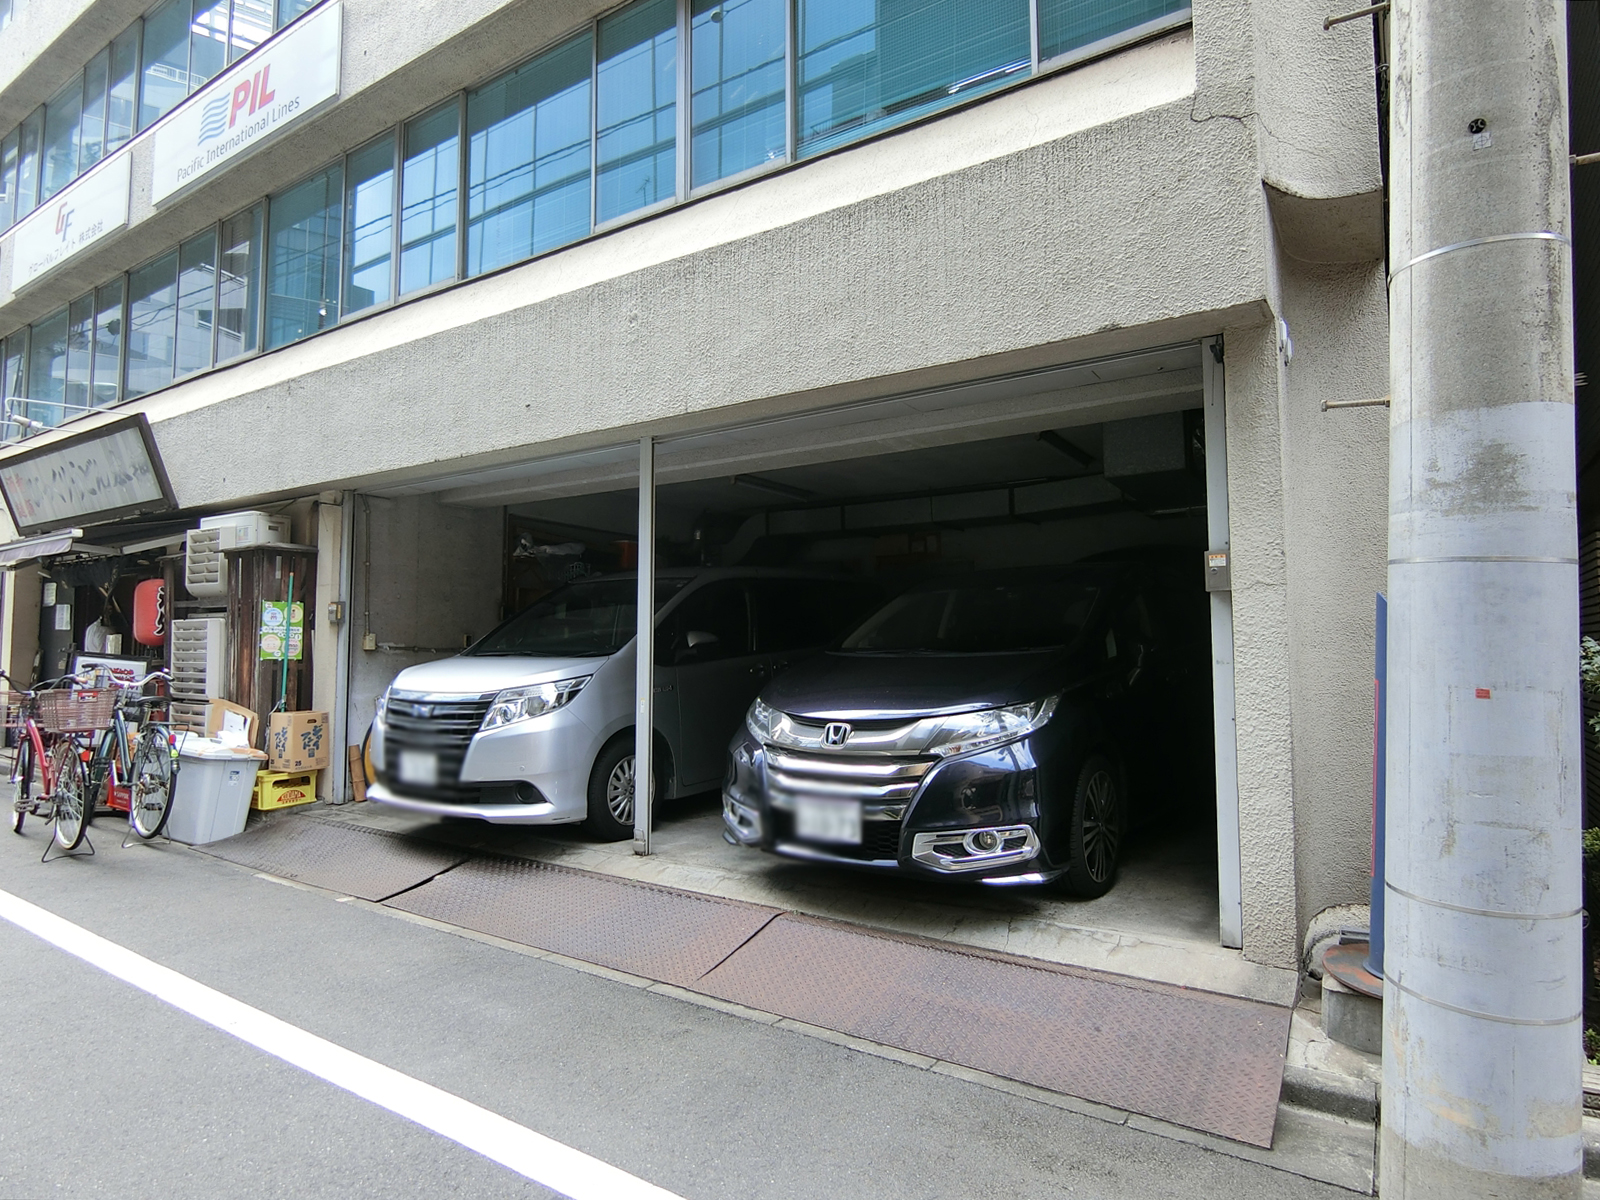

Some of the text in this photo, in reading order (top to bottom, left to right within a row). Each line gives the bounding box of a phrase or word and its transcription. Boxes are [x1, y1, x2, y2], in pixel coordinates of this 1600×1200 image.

[228, 63, 276, 129] PIL
[177, 96, 300, 182] Pacific International Lines
[79, 219, 104, 245] 株式会社
